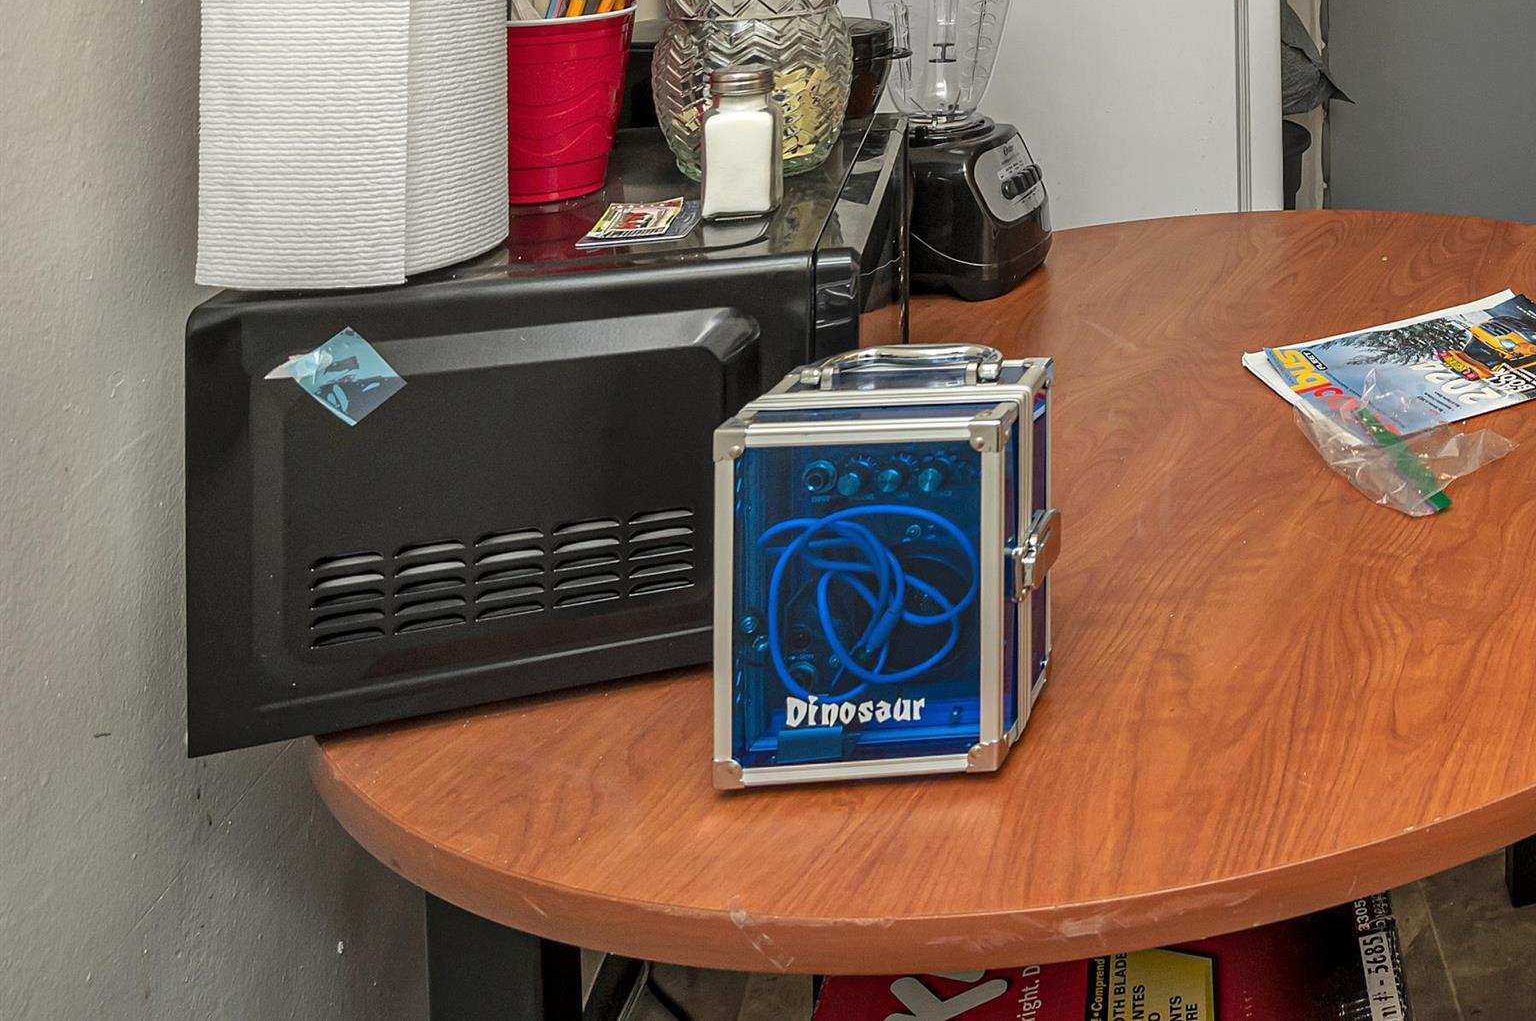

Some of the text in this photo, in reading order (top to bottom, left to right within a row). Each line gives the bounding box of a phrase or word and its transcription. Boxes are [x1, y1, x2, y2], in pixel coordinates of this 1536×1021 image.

[1303, 350, 1328, 371] FLEET
[786, 695, 925, 727] Dinosaur
[1363, 936, 1388, 975] 5685
[1131, 984, 1145, 1021] NTES
